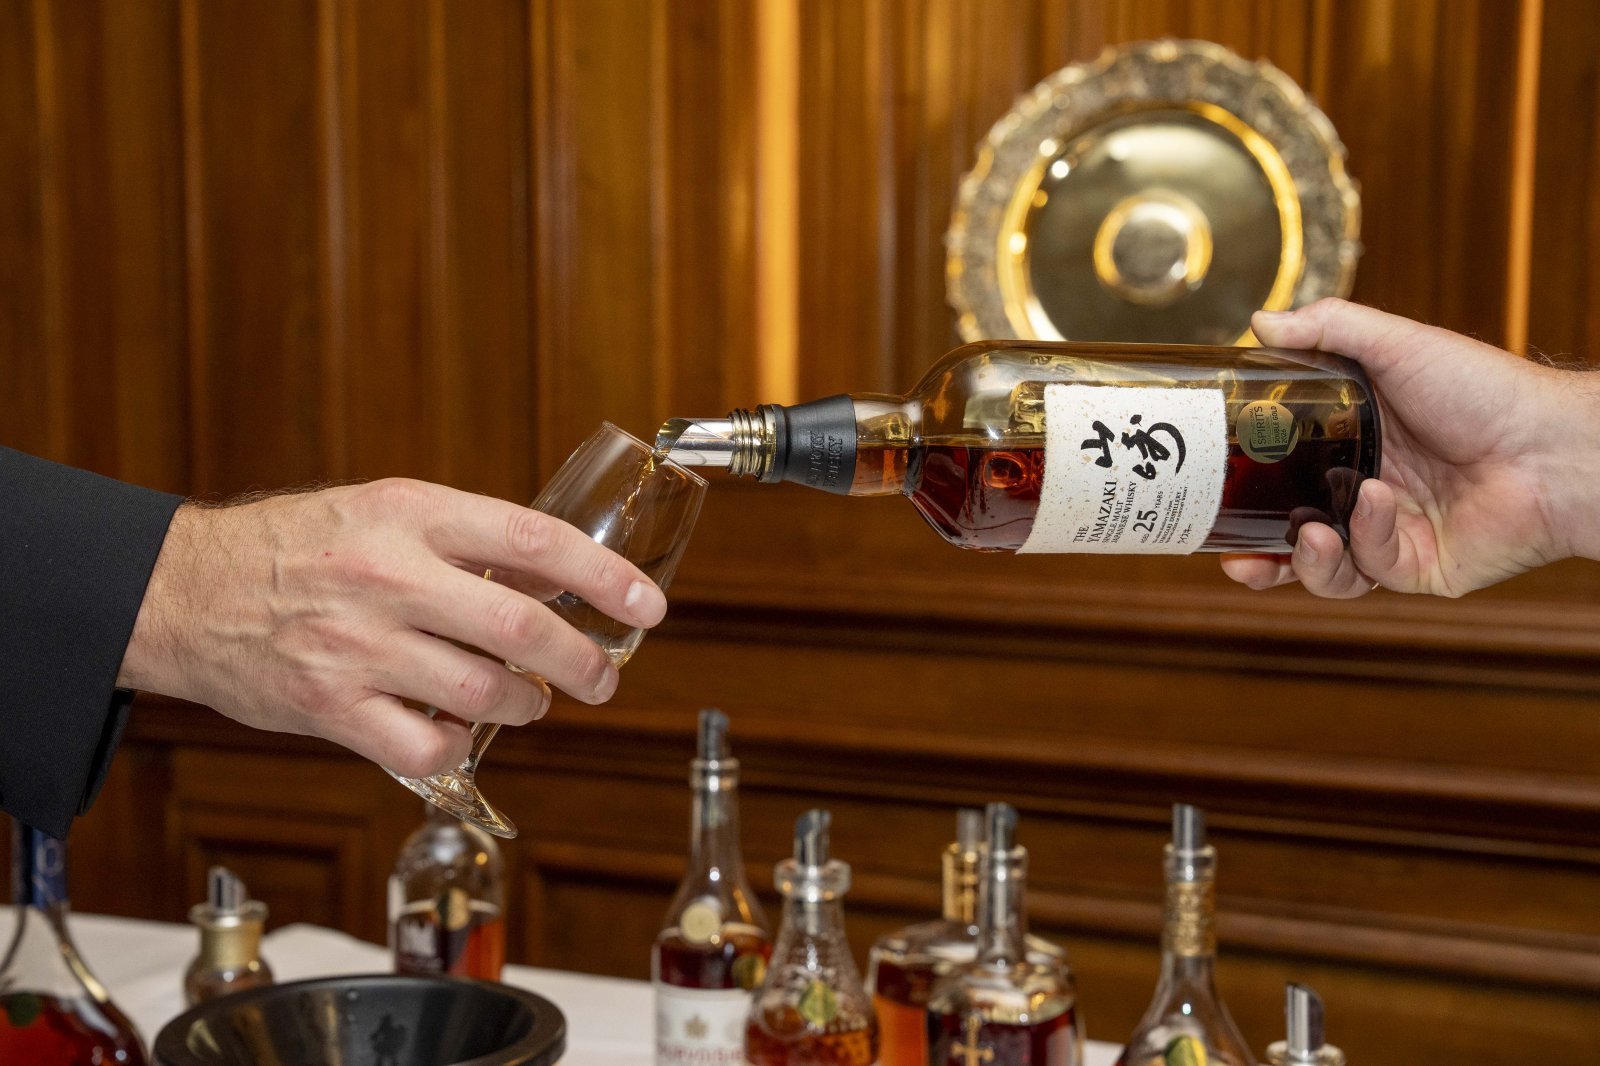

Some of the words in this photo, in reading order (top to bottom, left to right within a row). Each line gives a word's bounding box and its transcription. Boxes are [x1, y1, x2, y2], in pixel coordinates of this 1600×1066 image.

[1254, 406, 1266, 445] SPIRITS
[1271, 405, 1279, 421] GOLD
[1272, 421, 1281, 444] DOUBLE
[1086, 481, 1117, 543] YAMAZAKI
[1101, 522, 1118, 543] SINGLE
[1112, 500, 1124, 522] MALT
[1111, 514, 1130, 544] JAPANESE
[1124, 481, 1137, 513] WHISKY
[1132, 510, 1158, 533] 25
[1155, 490, 1164, 509] YEARS
[1073, 526, 1090, 543] THE
